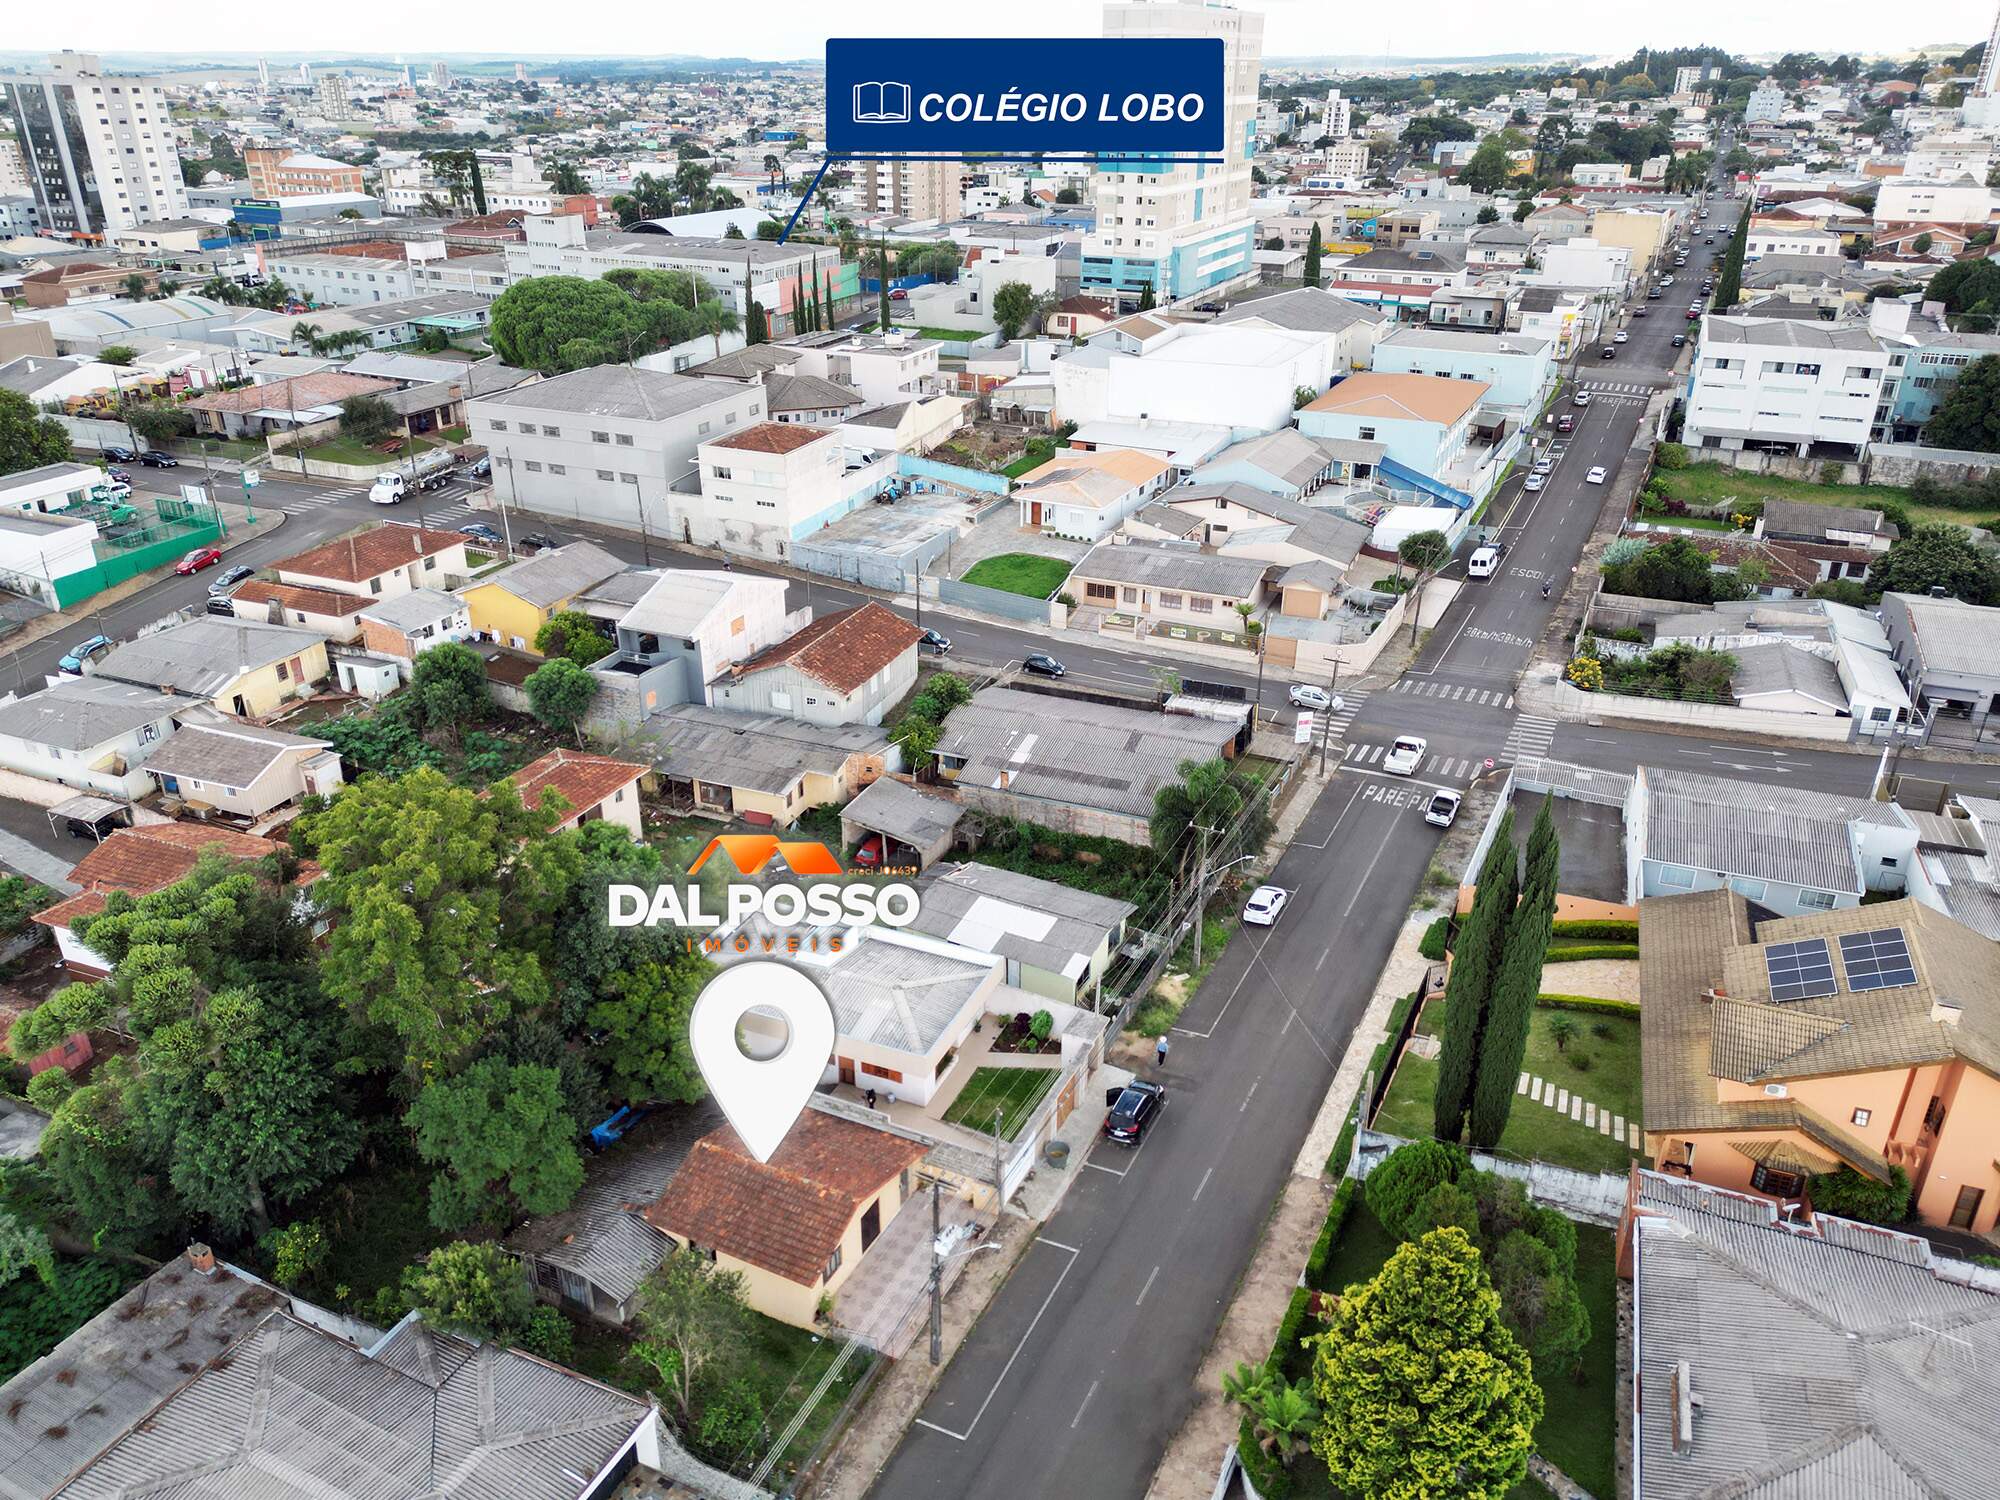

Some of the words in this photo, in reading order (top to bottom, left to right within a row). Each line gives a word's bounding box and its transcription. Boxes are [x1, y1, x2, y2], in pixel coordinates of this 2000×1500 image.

[1621, 398, 1644, 407] PARE
[1362, 785, 1408, 807] PARE
[1408, 795, 1430, 812] PA
